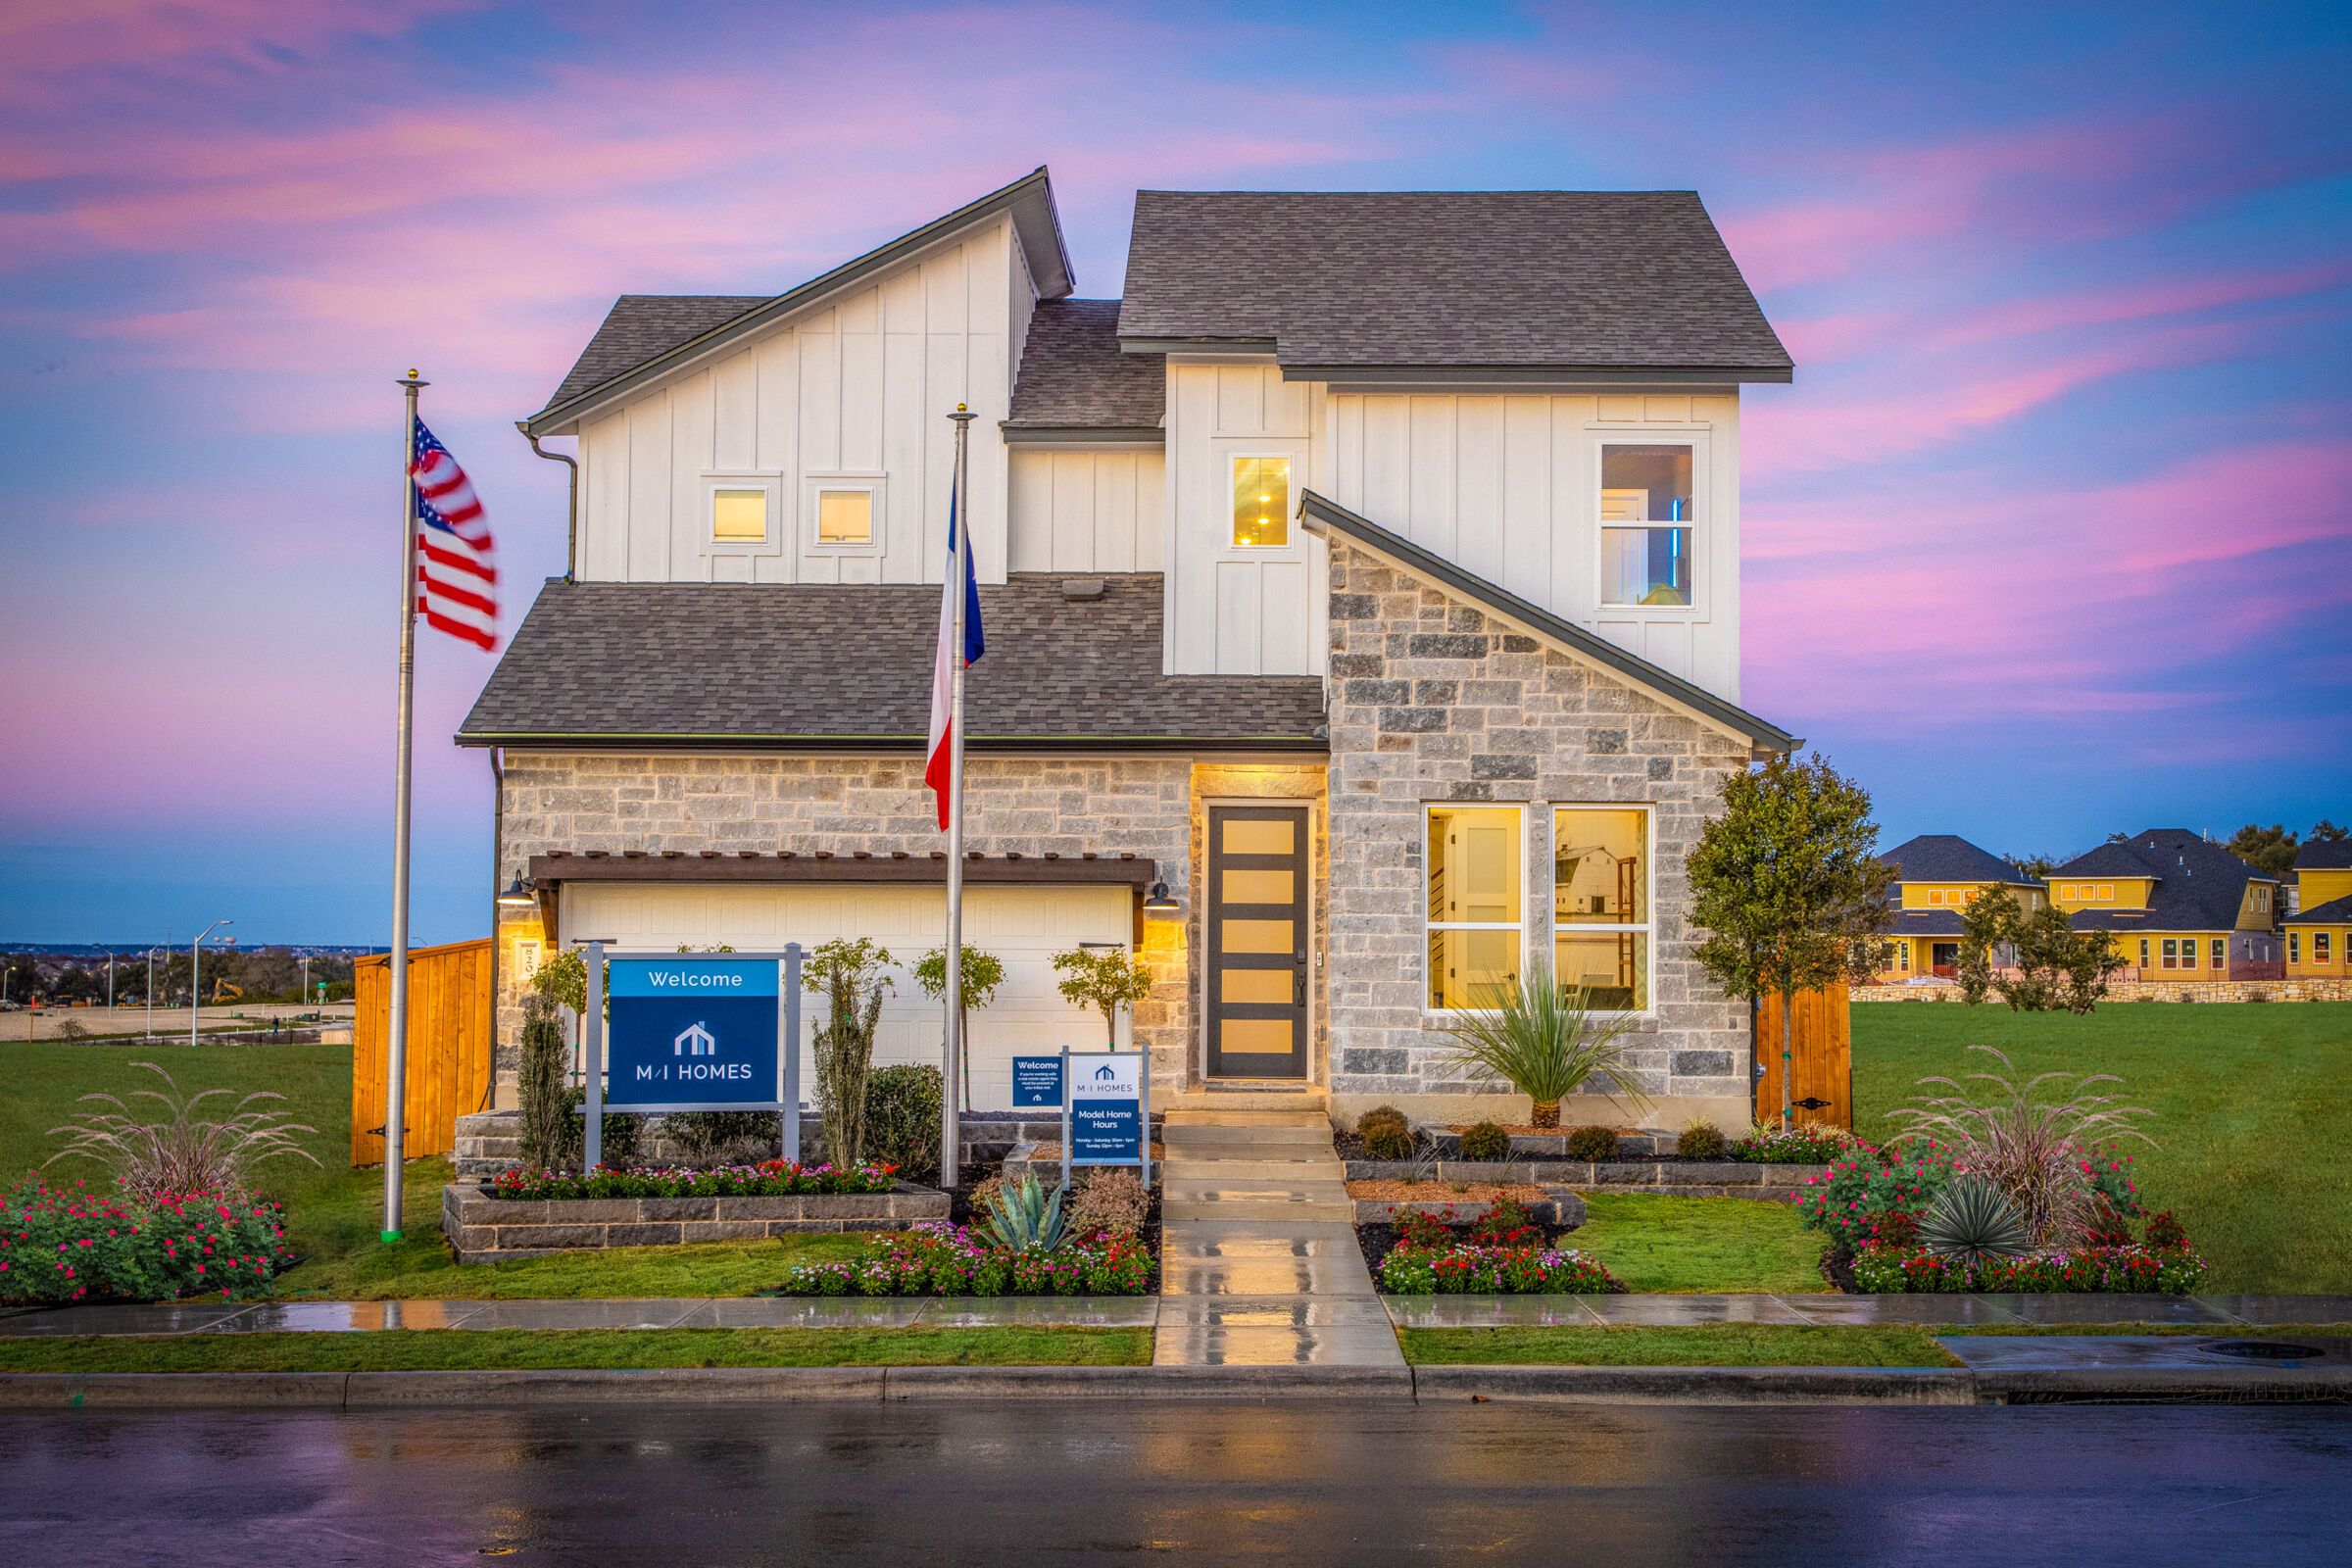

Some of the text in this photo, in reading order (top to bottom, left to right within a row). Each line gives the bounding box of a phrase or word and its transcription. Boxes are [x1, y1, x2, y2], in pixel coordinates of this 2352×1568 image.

[648, 971, 743, 987] Welcome
[678, 1063, 752, 1080] HOMES
[1098, 1084, 1133, 1093] HOMES
[1078, 1110, 1132, 1119] Model Home
[1093, 1120, 1118, 1129] Hours
